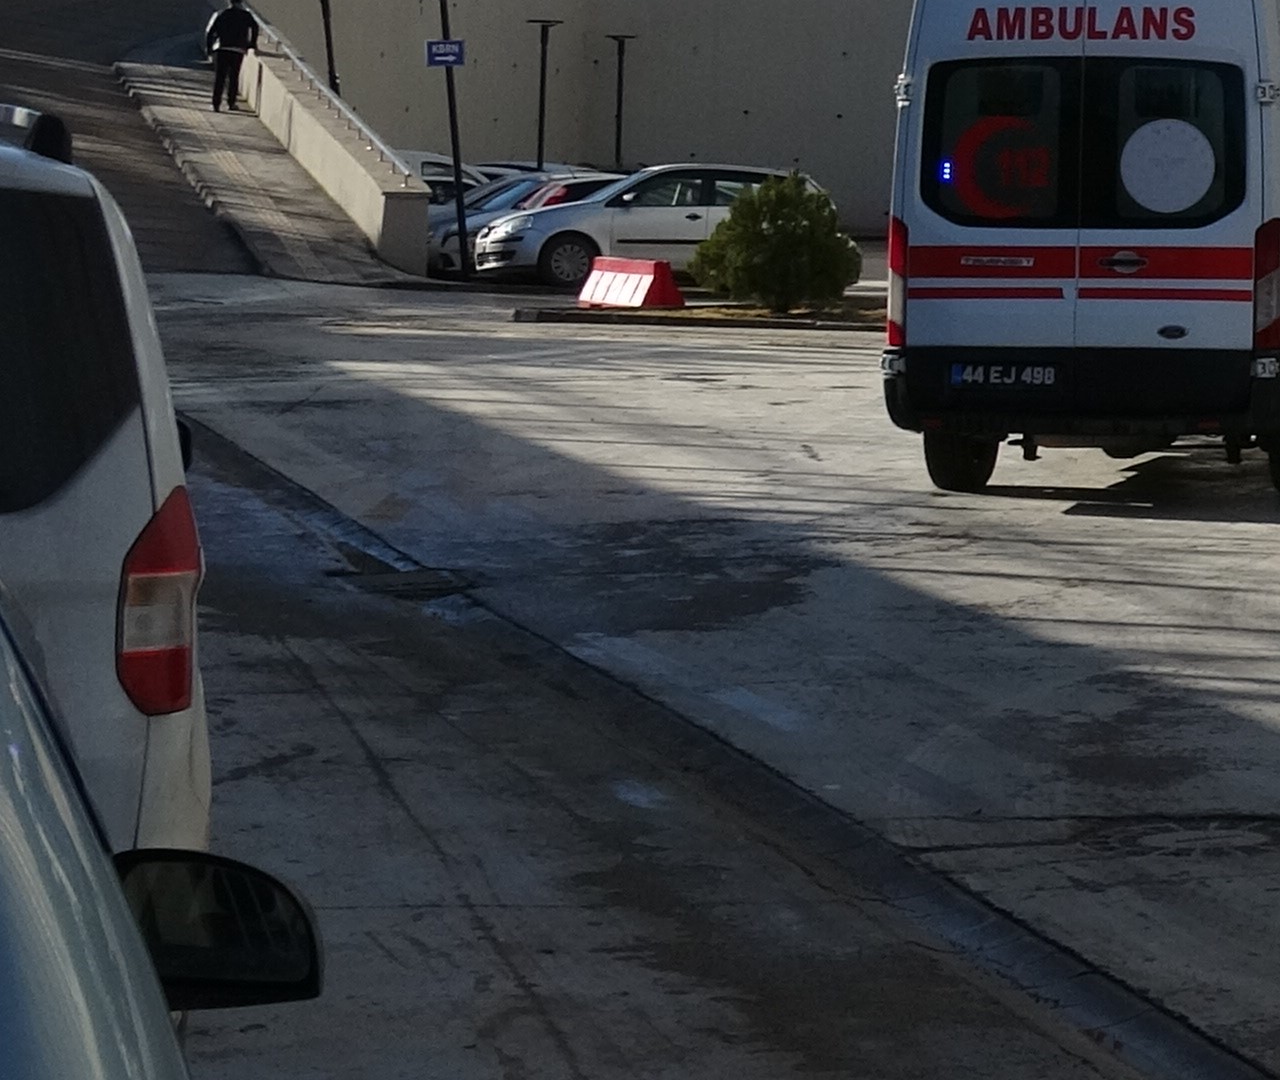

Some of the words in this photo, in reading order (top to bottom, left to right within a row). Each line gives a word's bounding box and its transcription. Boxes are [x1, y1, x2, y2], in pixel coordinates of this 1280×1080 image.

[967, 5, 1197, 41] AMBULANS
[962, 365, 985, 383] 44
[989, 365, 1016, 384] EJ
[1021, 366, 1055, 385] 498
